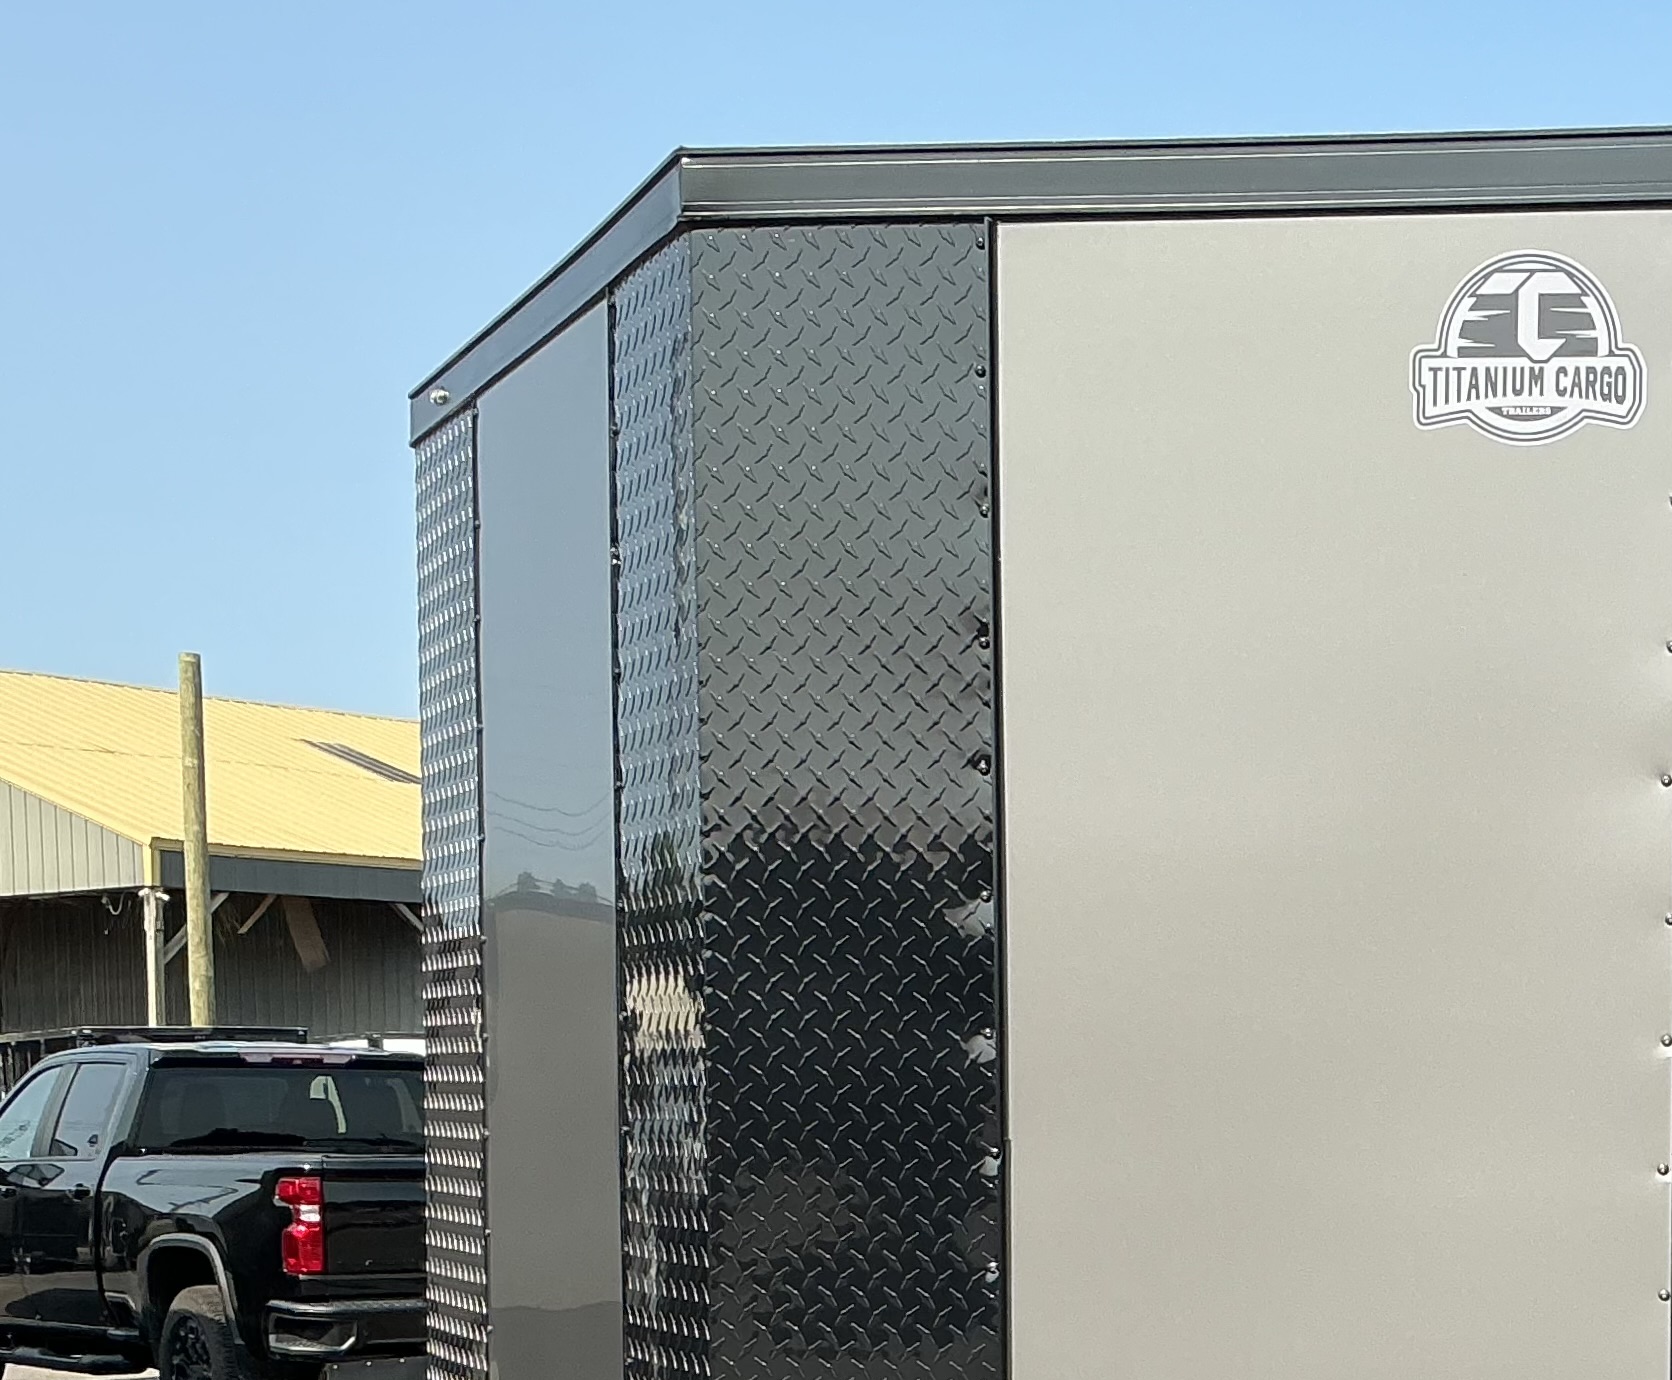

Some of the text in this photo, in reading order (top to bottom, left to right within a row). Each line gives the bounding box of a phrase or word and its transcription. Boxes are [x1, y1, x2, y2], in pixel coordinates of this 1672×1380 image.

[1428, 366, 1627, 407] TITANIUM CARGO
[1501, 406, 1552, 415] TRAILERS
